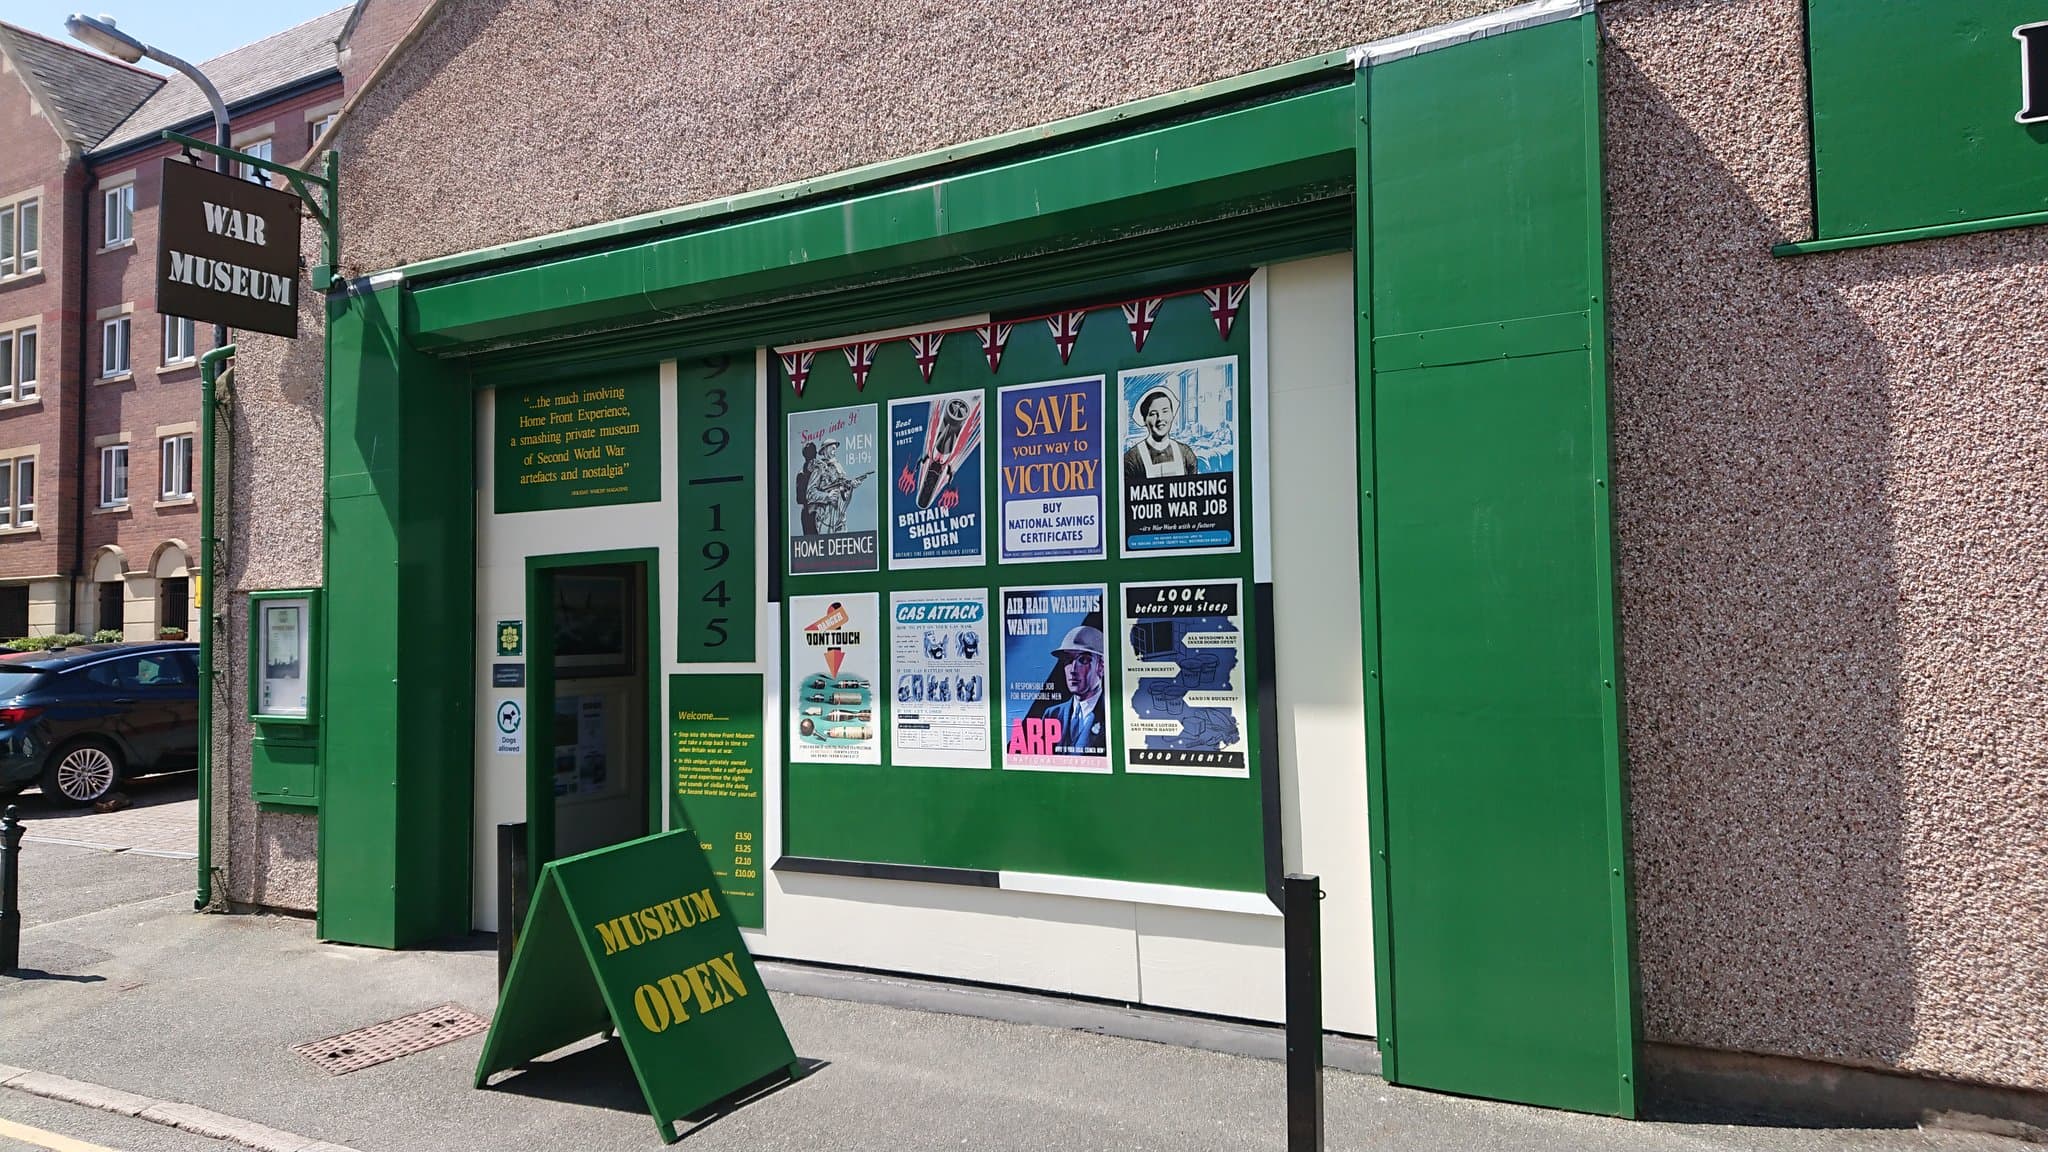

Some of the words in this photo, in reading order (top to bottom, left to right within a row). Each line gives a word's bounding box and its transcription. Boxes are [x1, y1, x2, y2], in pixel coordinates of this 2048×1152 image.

[203, 201, 266, 246] WAR
[168, 250, 291, 306] MUSEUM
[555, 392, 578, 404] much
[583, 388, 624, 402] involving
[520, 416, 545, 428] Home
[550, 412, 573, 425] Front
[578, 406, 630, 422] Experience,
[1015, 392, 1087, 437] SAVE
[829, 418, 845, 433] into
[510, 437, 516, 446] a
[520, 431, 561, 446] smashing
[565, 427, 596, 443] private
[600, 423, 640, 437] museum
[845, 433, 872, 450] MEN
[524, 453, 532, 465] of
[538, 450, 569, 465] Second
[574, 447, 600, 460] World
[605, 446, 624, 457] War
[1013, 444, 1042, 460] your
[1045, 441, 1070, 456] way
[1074, 439, 1088, 452] to
[520, 469, 557, 484] artefacts
[561, 468, 578, 480] and
[1003, 459, 1099, 495] VICTORY
[1130, 484, 1164, 501] MAKE
[1169, 479, 1227, 498] NURSING
[899, 506, 949, 527] BRITAIN
[1043, 502, 1062, 514] BUY
[1131, 504, 1162, 520] YOUR
[1168, 501, 1197, 518] WAR
[1202, 499, 1227, 515] JOB
[909, 520, 948, 539] SHALL
[950, 514, 975, 530] NOT
[1009, 517, 1053, 530] NATIONAL
[1056, 515, 1095, 527] SAVINGS
[1196, 522, 1216, 530] future
[923, 531, 958, 550] BURN
[1020, 530, 1083, 543] CERTIFICATES
[794, 540, 824, 558] HOME
[828, 536, 874, 556] DEFENCE
[1157, 588, 1206, 602] LOOK
[898, 606, 926, 620] GAS
[928, 604, 980, 620] ATTACK
[1007, 598, 1024, 614] AIR
[1026, 597, 1049, 614] RAID
[1050, 595, 1100, 614] WARDENS
[1135, 603, 1168, 614] before
[1172, 604, 1192, 615] you
[1198, 602, 1228, 614] sleep
[1007, 618, 1048, 635] WANTED
[831, 632, 860, 645] TOUCH
[1015, 682, 1044, 690] RESPONSIBLE
[1046, 682, 1054, 690] JOB
[1011, 692, 1020, 700] FOR
[1021, 692, 1050, 700] RESPONSIBLE
[1051, 692, 1061, 700] MEN
[502, 736, 516, 744] Dogs
[1009, 717, 1062, 755] ARP
[1140, 752, 1171, 760] GOOD
[735, 832, 752, 840] £3.50
[700, 842, 712, 850] ions
[735, 844, 751, 853] £3.25
[735, 857, 752, 865] £2.10
[735, 869, 756, 878] £10.00
[594, 888, 721, 956] MUSEUM
[634, 952, 748, 1033] OPEN
